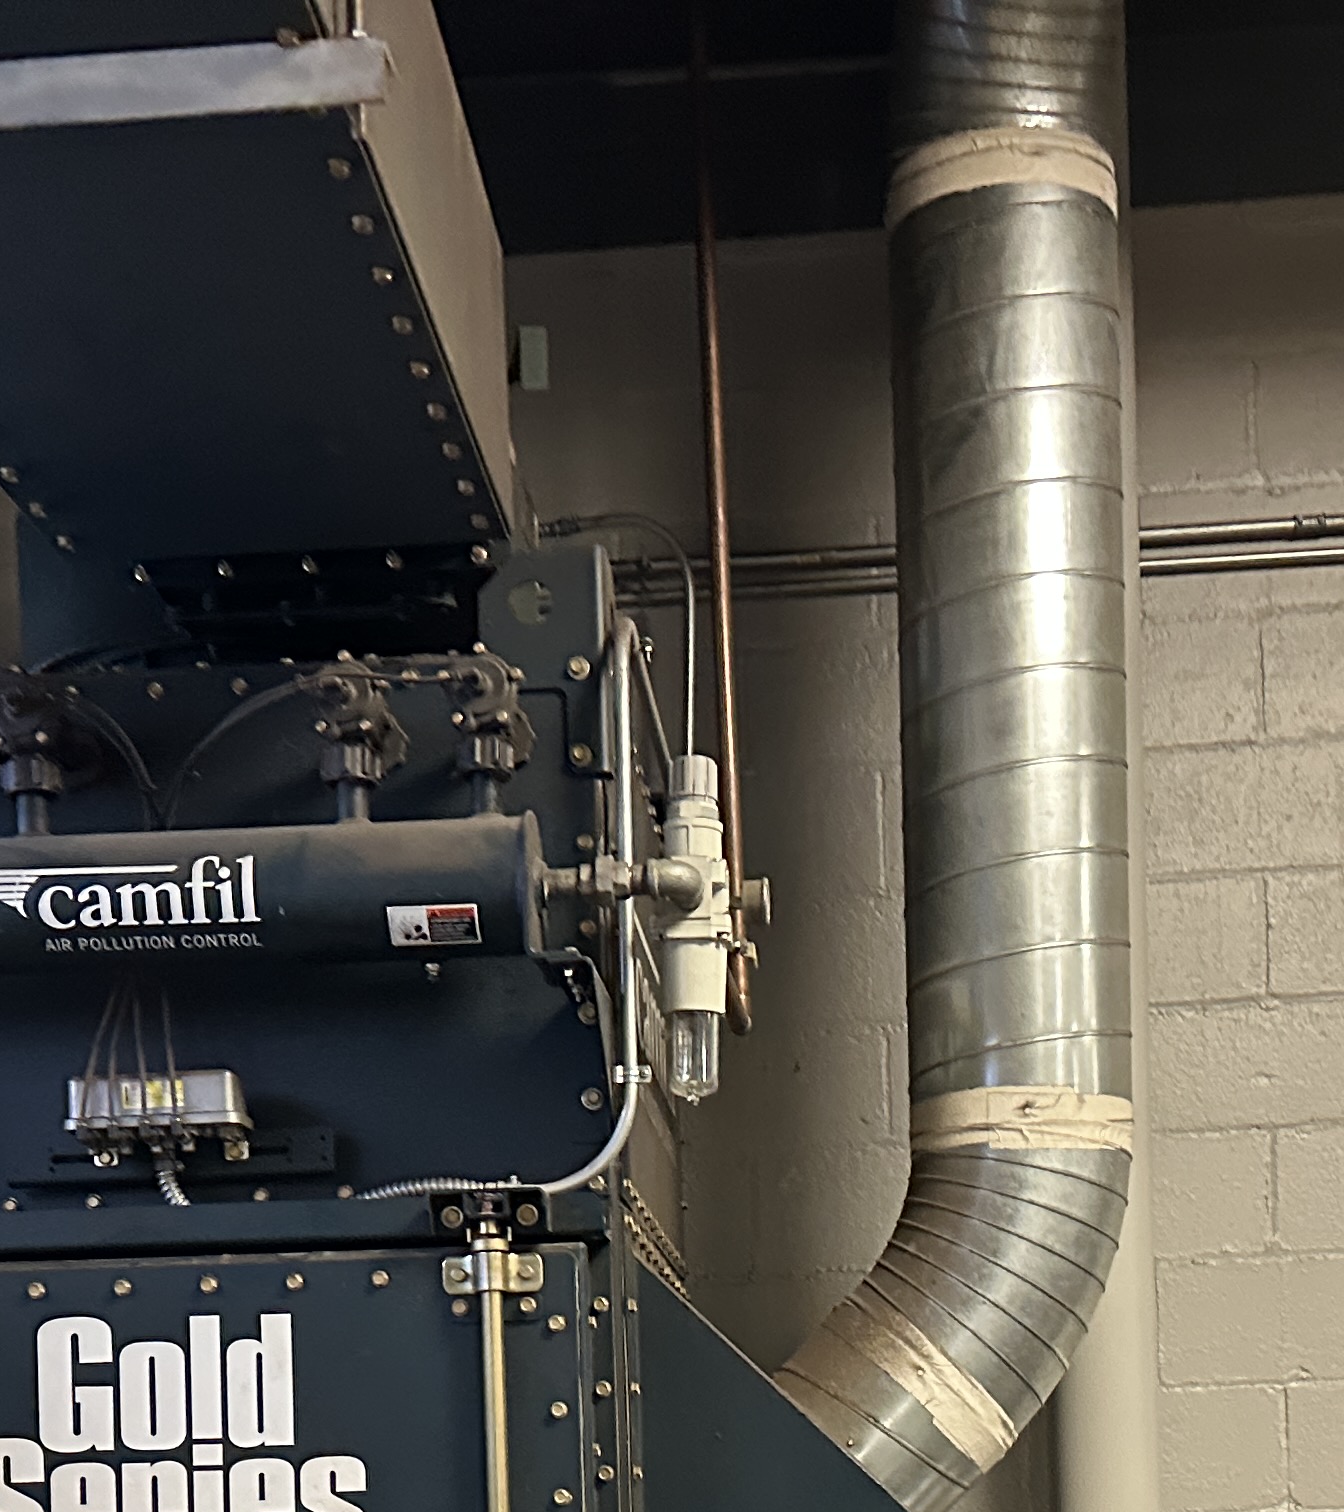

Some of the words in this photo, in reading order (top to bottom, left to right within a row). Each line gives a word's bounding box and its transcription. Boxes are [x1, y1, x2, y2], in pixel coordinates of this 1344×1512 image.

[38, 855, 261, 930] camfil
[45, 937, 73, 952] AIR
[79, 934, 175, 951] POLLUTION
[181, 933, 263, 948] CONTROL
[37, 1313, 295, 1453] Gold
